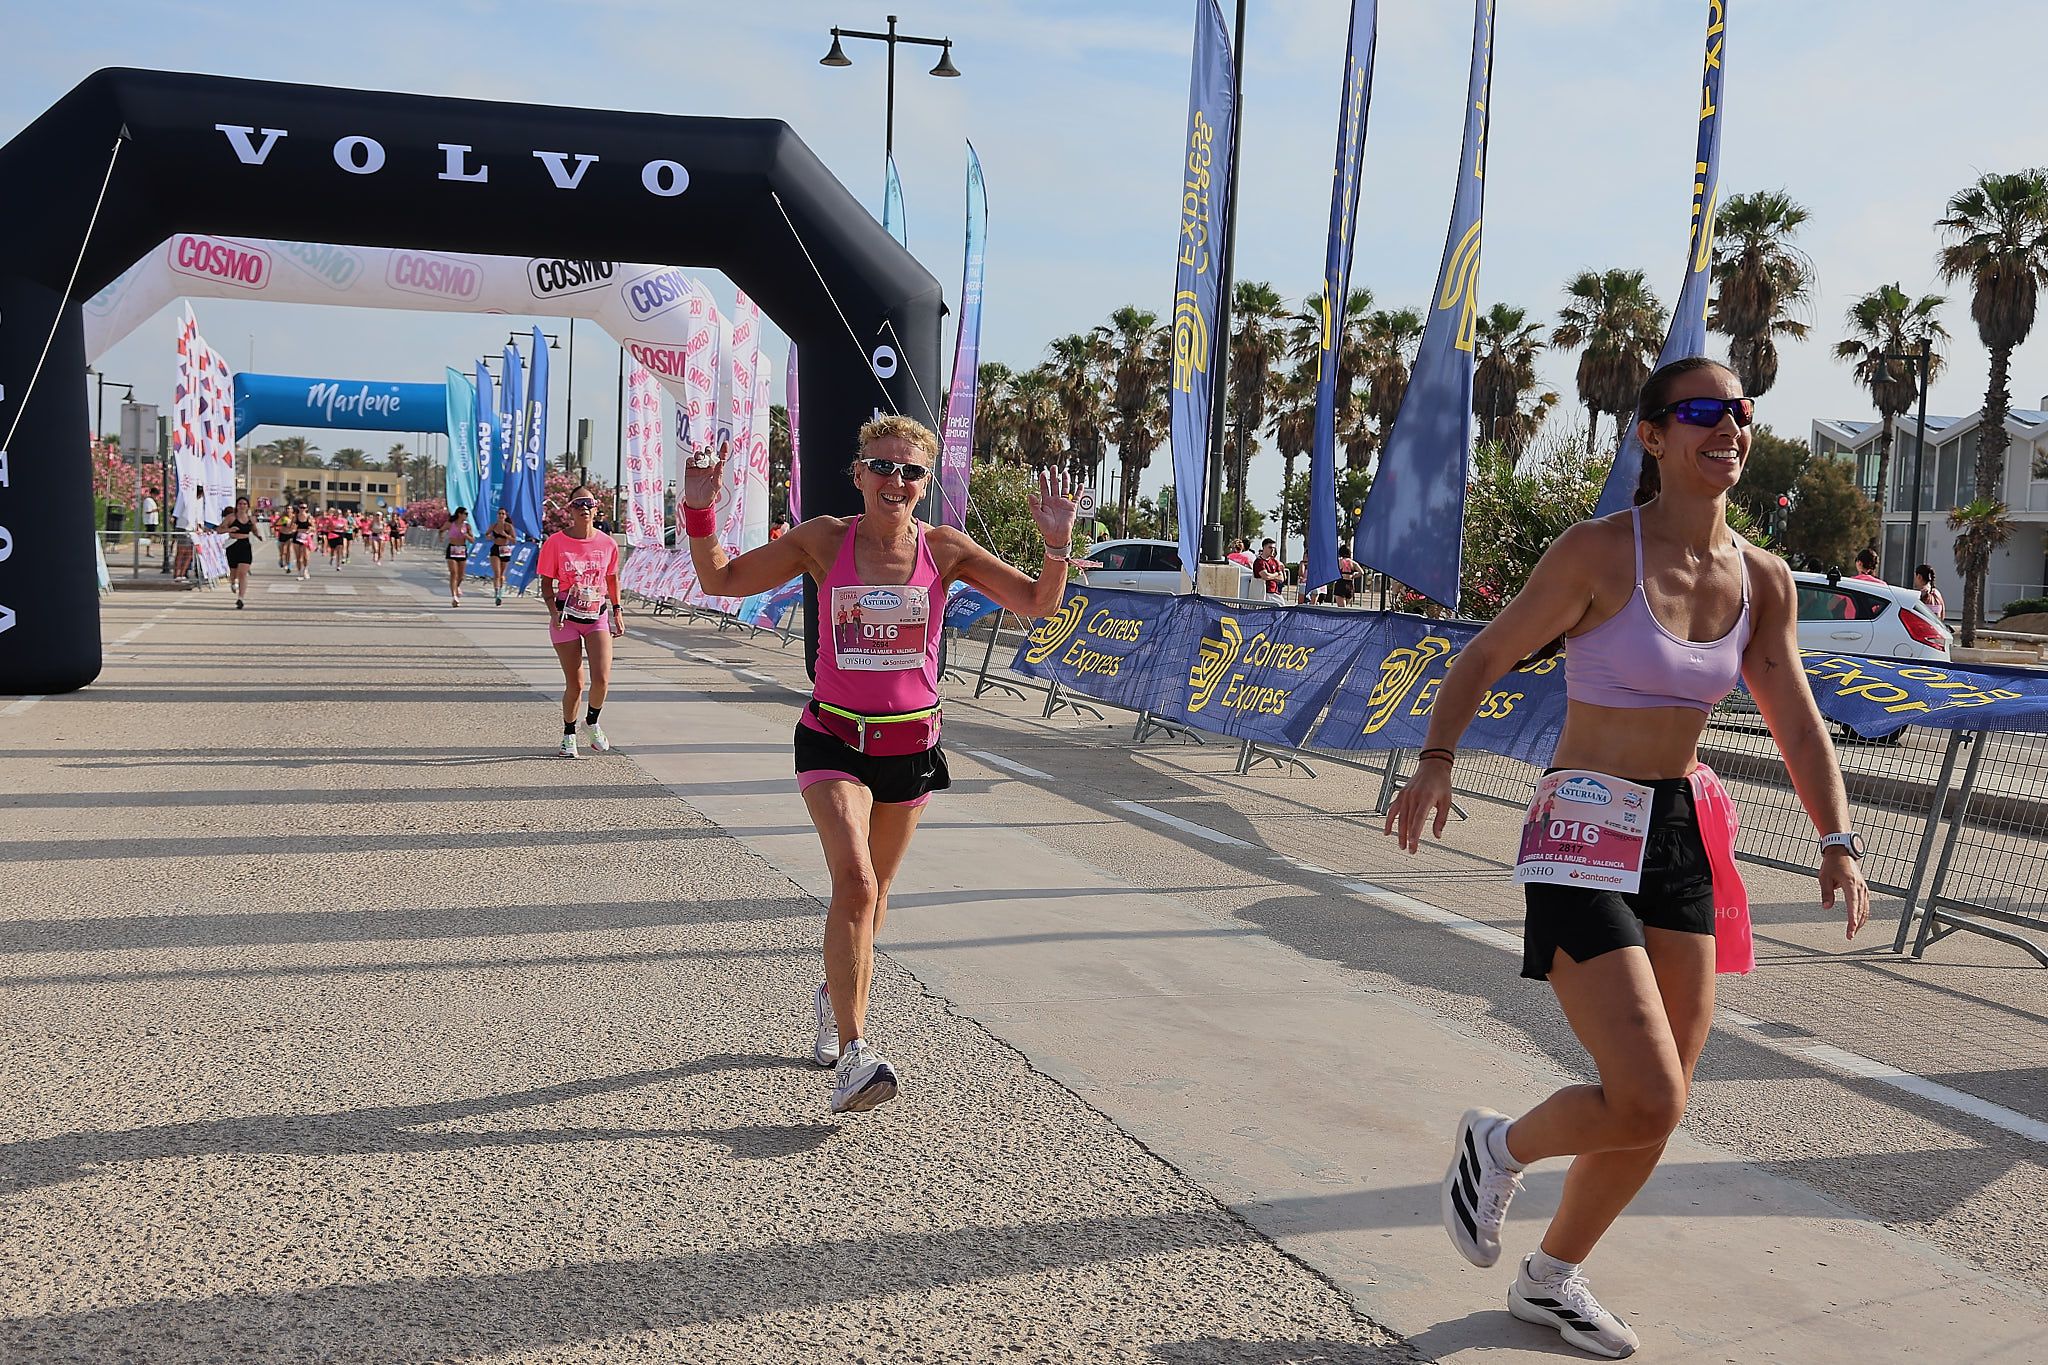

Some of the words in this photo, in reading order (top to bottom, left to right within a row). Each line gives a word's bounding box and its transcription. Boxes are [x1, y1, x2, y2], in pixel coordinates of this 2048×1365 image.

[213, 122, 690, 198] VOLVO
[178, 236, 262, 284] COSMO
[395, 254, 475, 297] COSMO
[630, 271, 692, 313] COSM
[630, 344, 686, 378] COSM
[307, 383, 400, 422] Marlene
[862, 598, 899, 606] ASTURIANA
[863, 624, 899, 639] 016
[1087, 609, 1143, 642] Correos
[845, 658, 872, 666] OYSHO
[1062, 639, 1125, 677] Express
[1242, 632, 1315, 671] Correos
[1221, 673, 1292, 718] Express
[1558, 785, 1607, 802] ASTURIANA
[1549, 820, 1600, 844] 016
[1558, 843, 1583, 854] 2817
[1520, 866, 1554, 877] OYSHO
[1522, 853, 1544, 862] CARRERA
[1564, 855, 1587, 864] MUJER
[1592, 860, 1625, 868] VALENCIA
[1580, 872, 1623, 884] Santander
